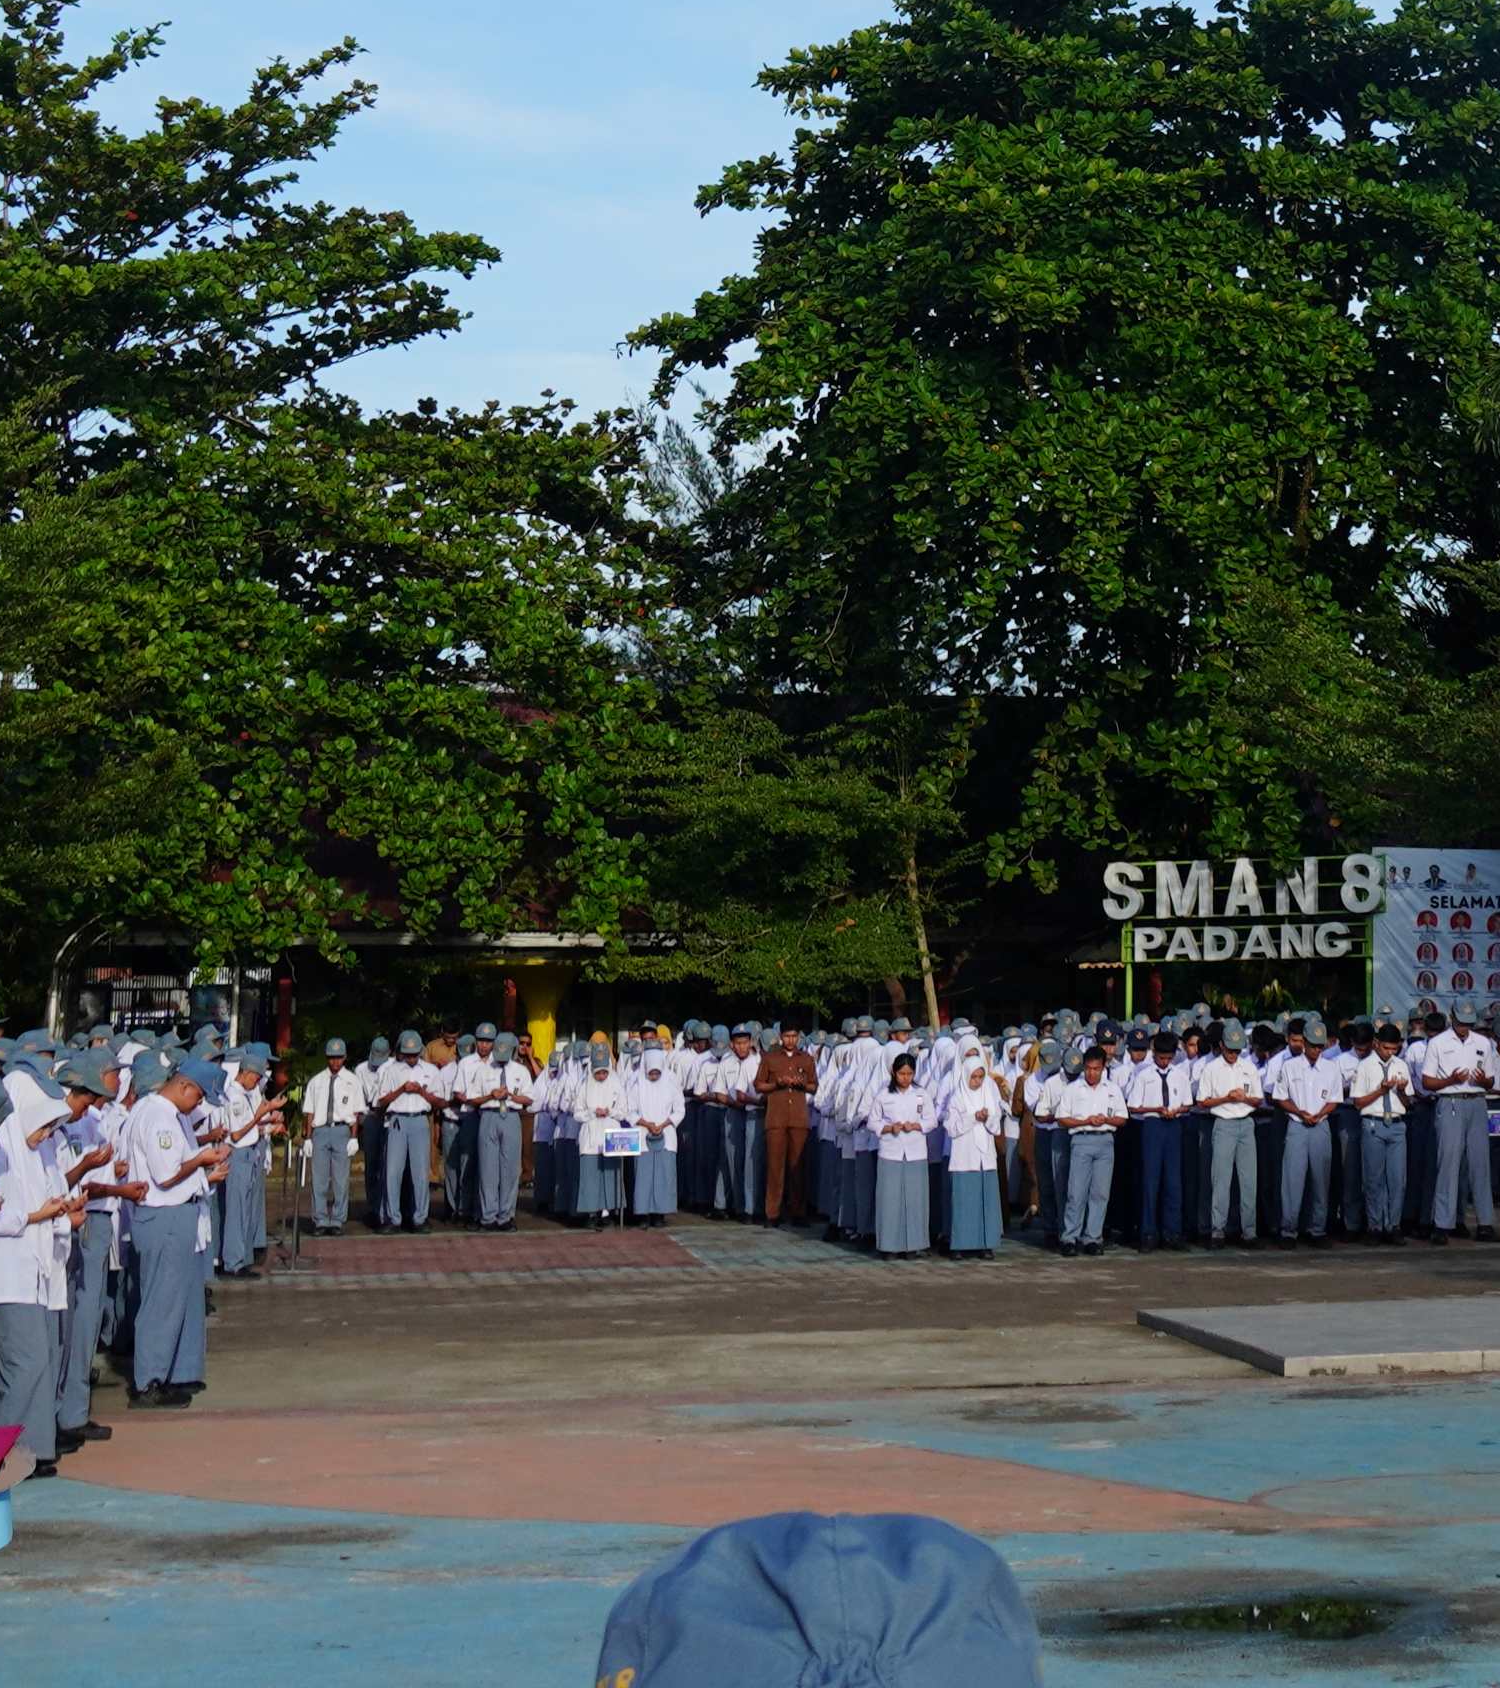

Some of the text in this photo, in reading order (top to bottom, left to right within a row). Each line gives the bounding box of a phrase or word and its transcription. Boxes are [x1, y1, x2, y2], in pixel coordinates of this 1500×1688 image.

[1103, 853, 1384, 920] SMAN 8
[1134, 921, 1353, 961] PADANG
